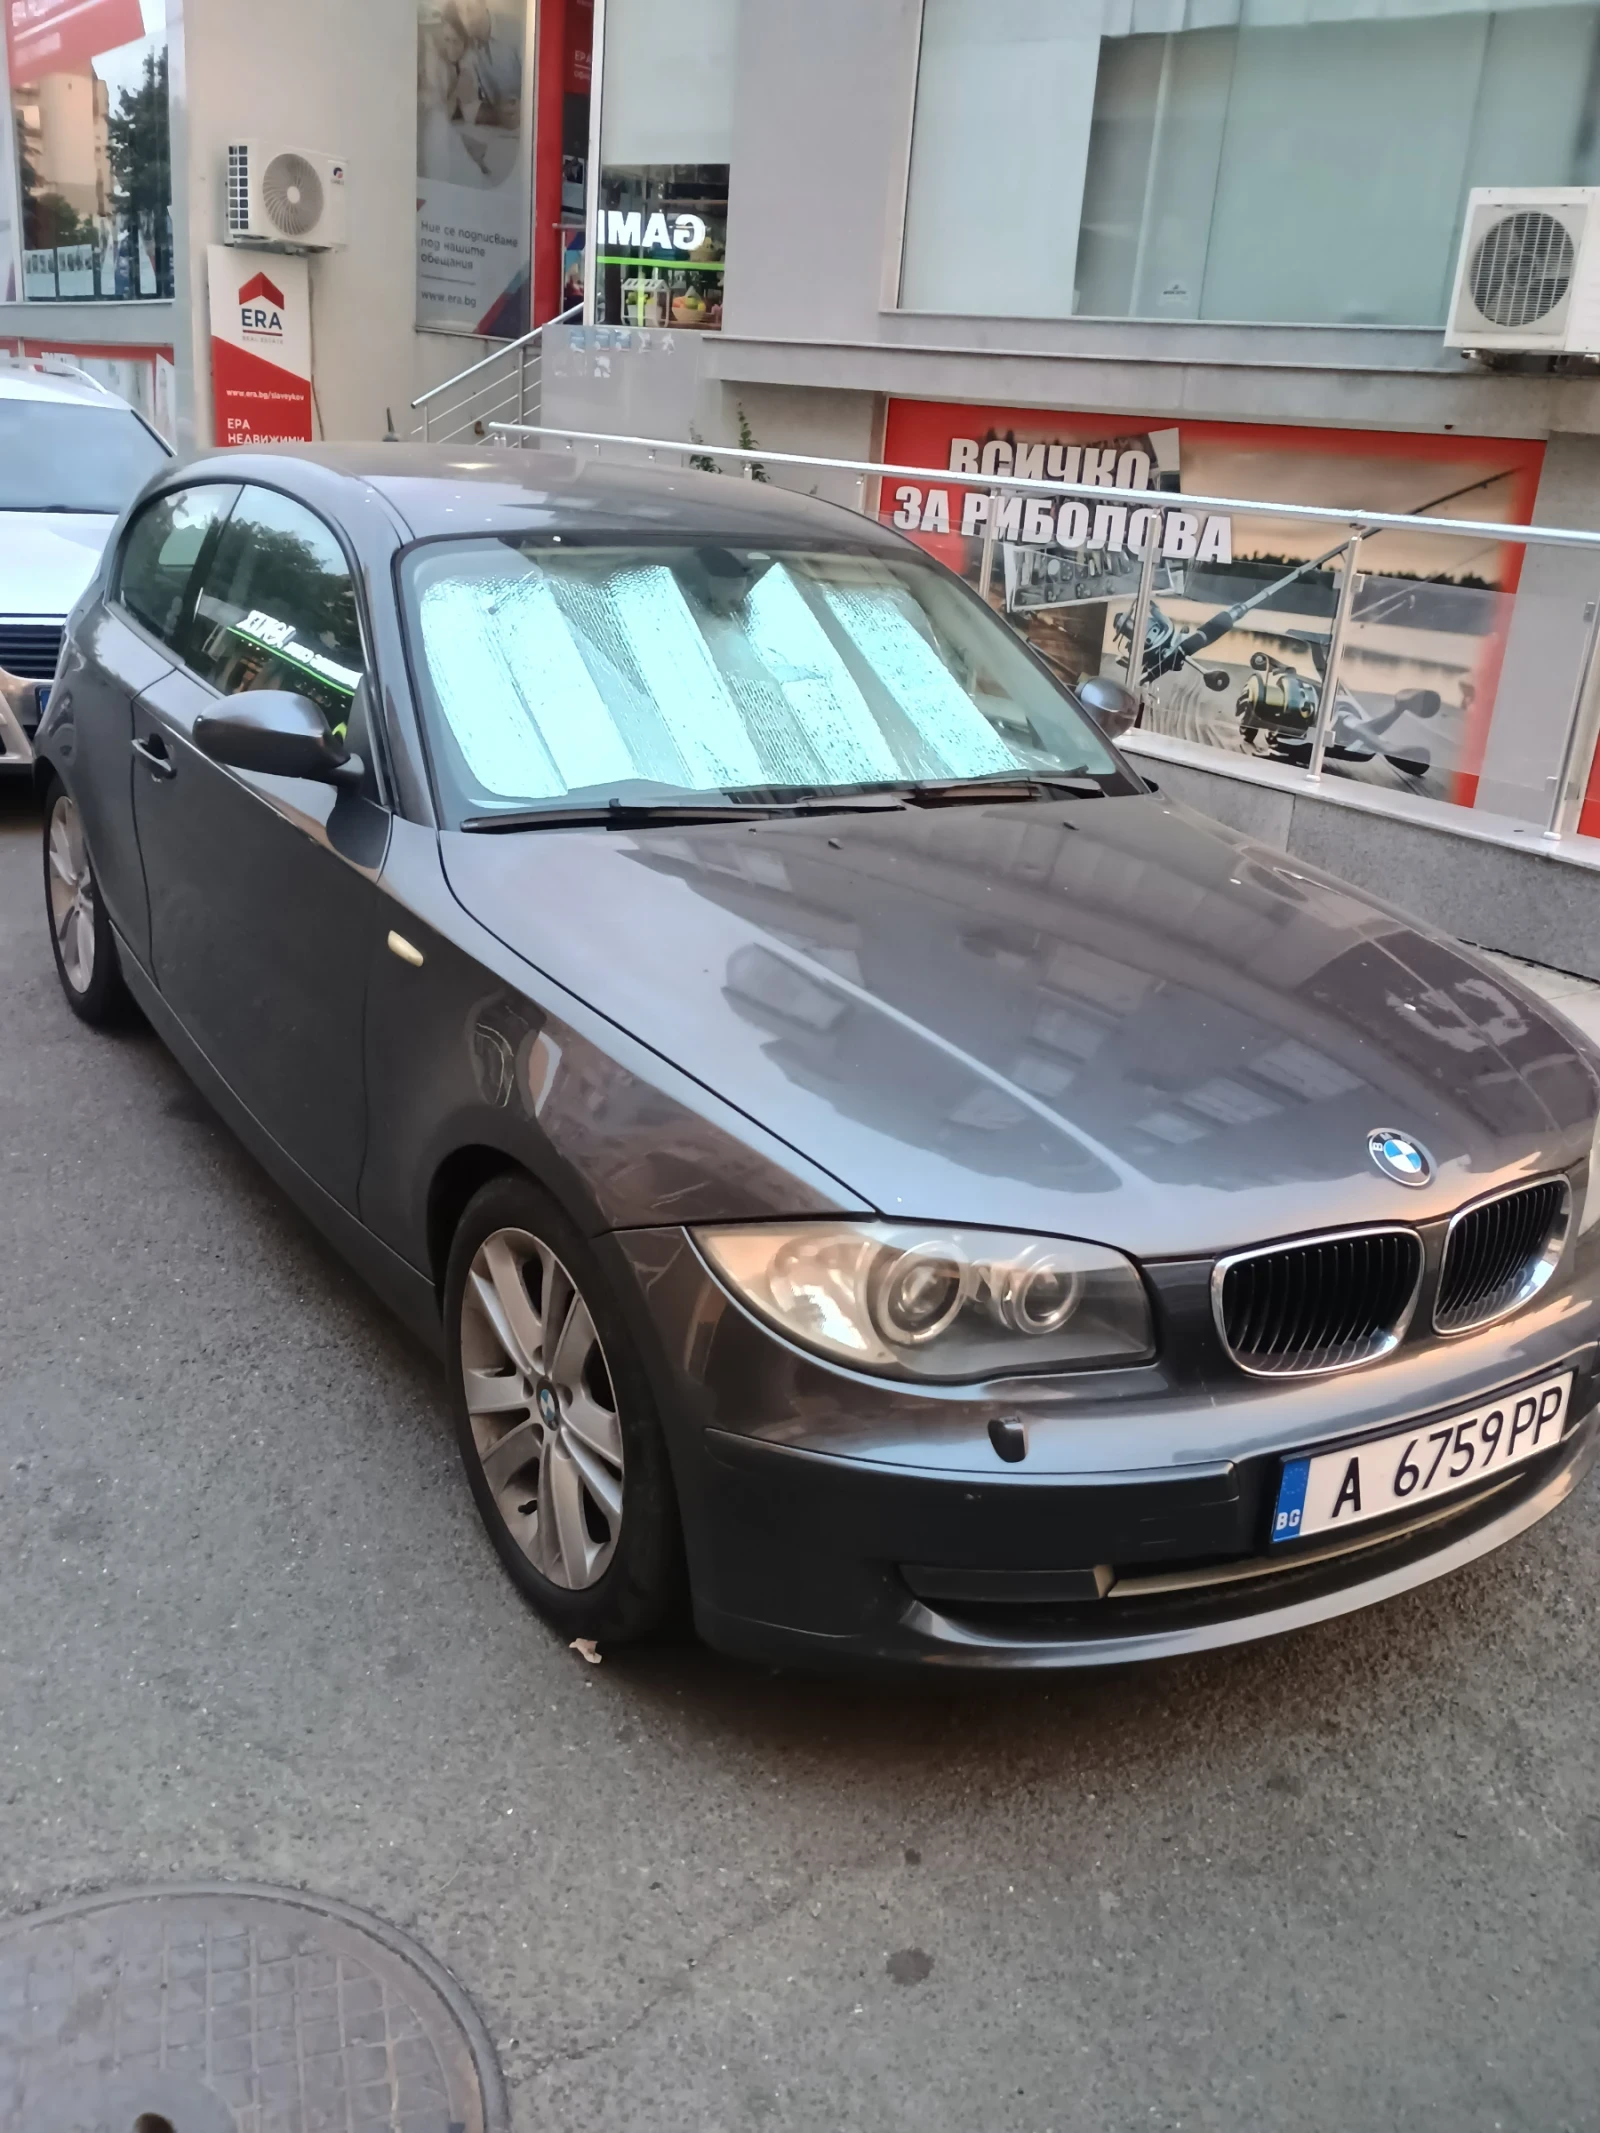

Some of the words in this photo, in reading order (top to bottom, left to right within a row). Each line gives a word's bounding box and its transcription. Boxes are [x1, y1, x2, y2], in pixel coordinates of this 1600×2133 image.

[421, 221, 441, 234] Ние
[444, 226, 455, 236] се
[458, 228, 518, 248] подписваме
[421, 237, 441, 251] под
[444, 241, 485, 257] нашите
[421, 252, 473, 270] обещания
[421, 291, 477, 308] www.era.bg
[241, 308, 282, 330] ERA
[226, 389, 305, 401] www.era.bg/slaveykov
[227, 418, 251, 430] ЕРА
[951, 438, 1150, 492] ВСИЧКО
[893, 486, 950, 533] ЗА
[961, 492, 1232, 564] РИБОЛОВА
[1331, 1456, 1361, 1518] A
[1275, 1508, 1301, 1531] BG
